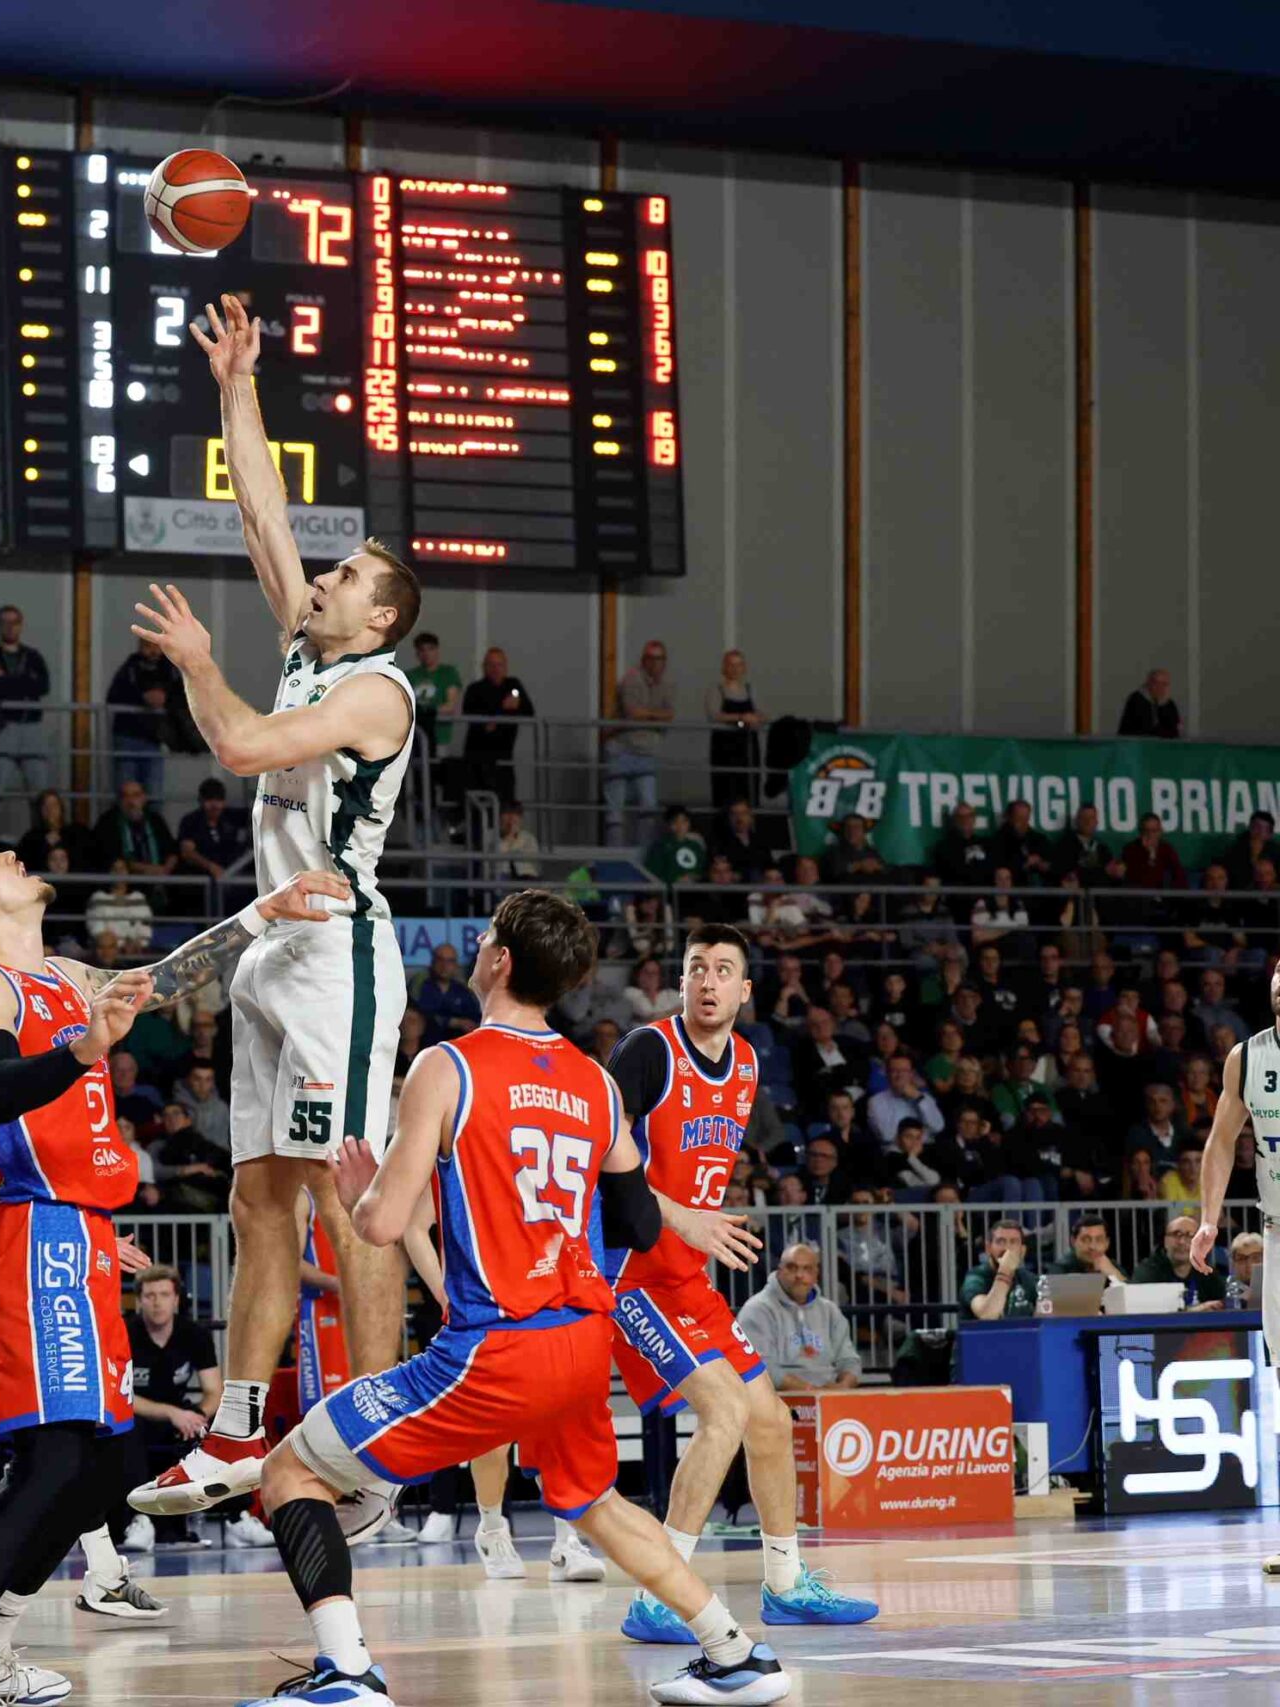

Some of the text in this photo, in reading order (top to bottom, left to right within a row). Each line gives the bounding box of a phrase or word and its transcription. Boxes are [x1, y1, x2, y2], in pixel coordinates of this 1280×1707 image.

[89, 209, 109, 239] 2
[374, 204, 392, 231] 2
[649, 197, 665, 225] 8
[288, 203, 352, 266] 72
[85, 265, 111, 294] 11
[155, 296, 185, 346] 2
[293, 306, 320, 353] 2
[654, 303, 670, 329] 3
[92, 320, 112, 350] 3
[93, 351, 113, 381] 5
[655, 356, 672, 383] 2
[898, 772, 1137, 832] TREVIGLIO
[509, 1084, 590, 1125] REGGIANI
[682, 1084, 692, 1108] 9
[289, 1101, 332, 1144] 55
[510, 1126, 592, 1238] 25
[40, 1296, 61, 1393] GLOBAL SERVICE
[53, 1295, 87, 1391] GEMINI
[620, 1295, 676, 1365] GEMINI
[836, 1427, 1009, 1463] D DURING
[877, 1461, 1010, 1481] Agenzia per il Lavoro
[880, 1496, 957, 1511] www.during.it
